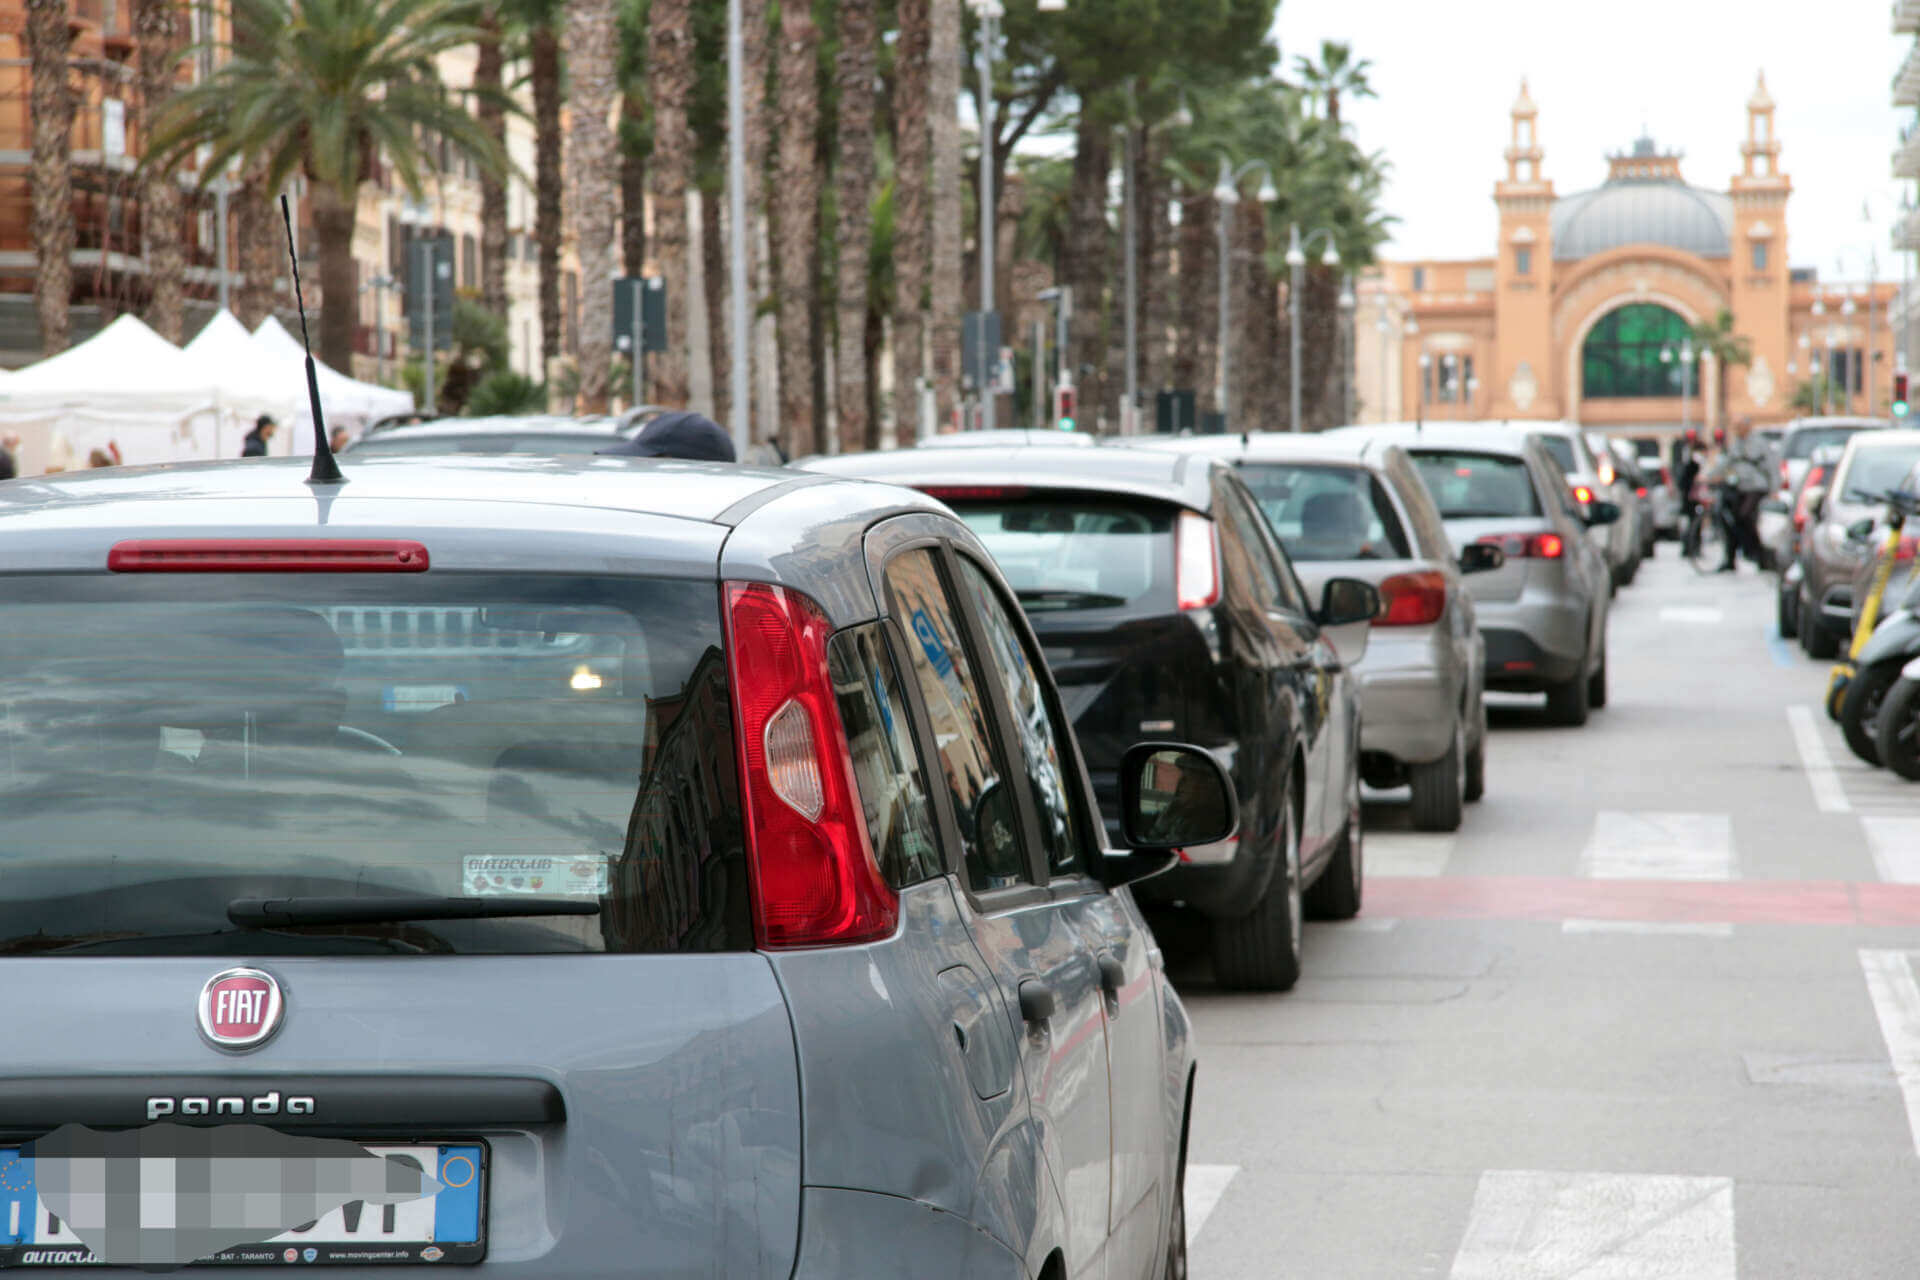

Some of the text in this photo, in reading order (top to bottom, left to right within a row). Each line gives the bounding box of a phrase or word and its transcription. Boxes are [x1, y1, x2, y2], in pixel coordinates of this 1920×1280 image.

[468, 858, 552, 870] AUTOCLUB
[216, 990, 266, 1024] FIAT
[147, 1092, 314, 1120] panda
[23, 1251, 106, 1263] AUTOCLU
[241, 1252, 275, 1260] TARANTO
[329, 1251, 409, 1260] www.movingcenter.info
